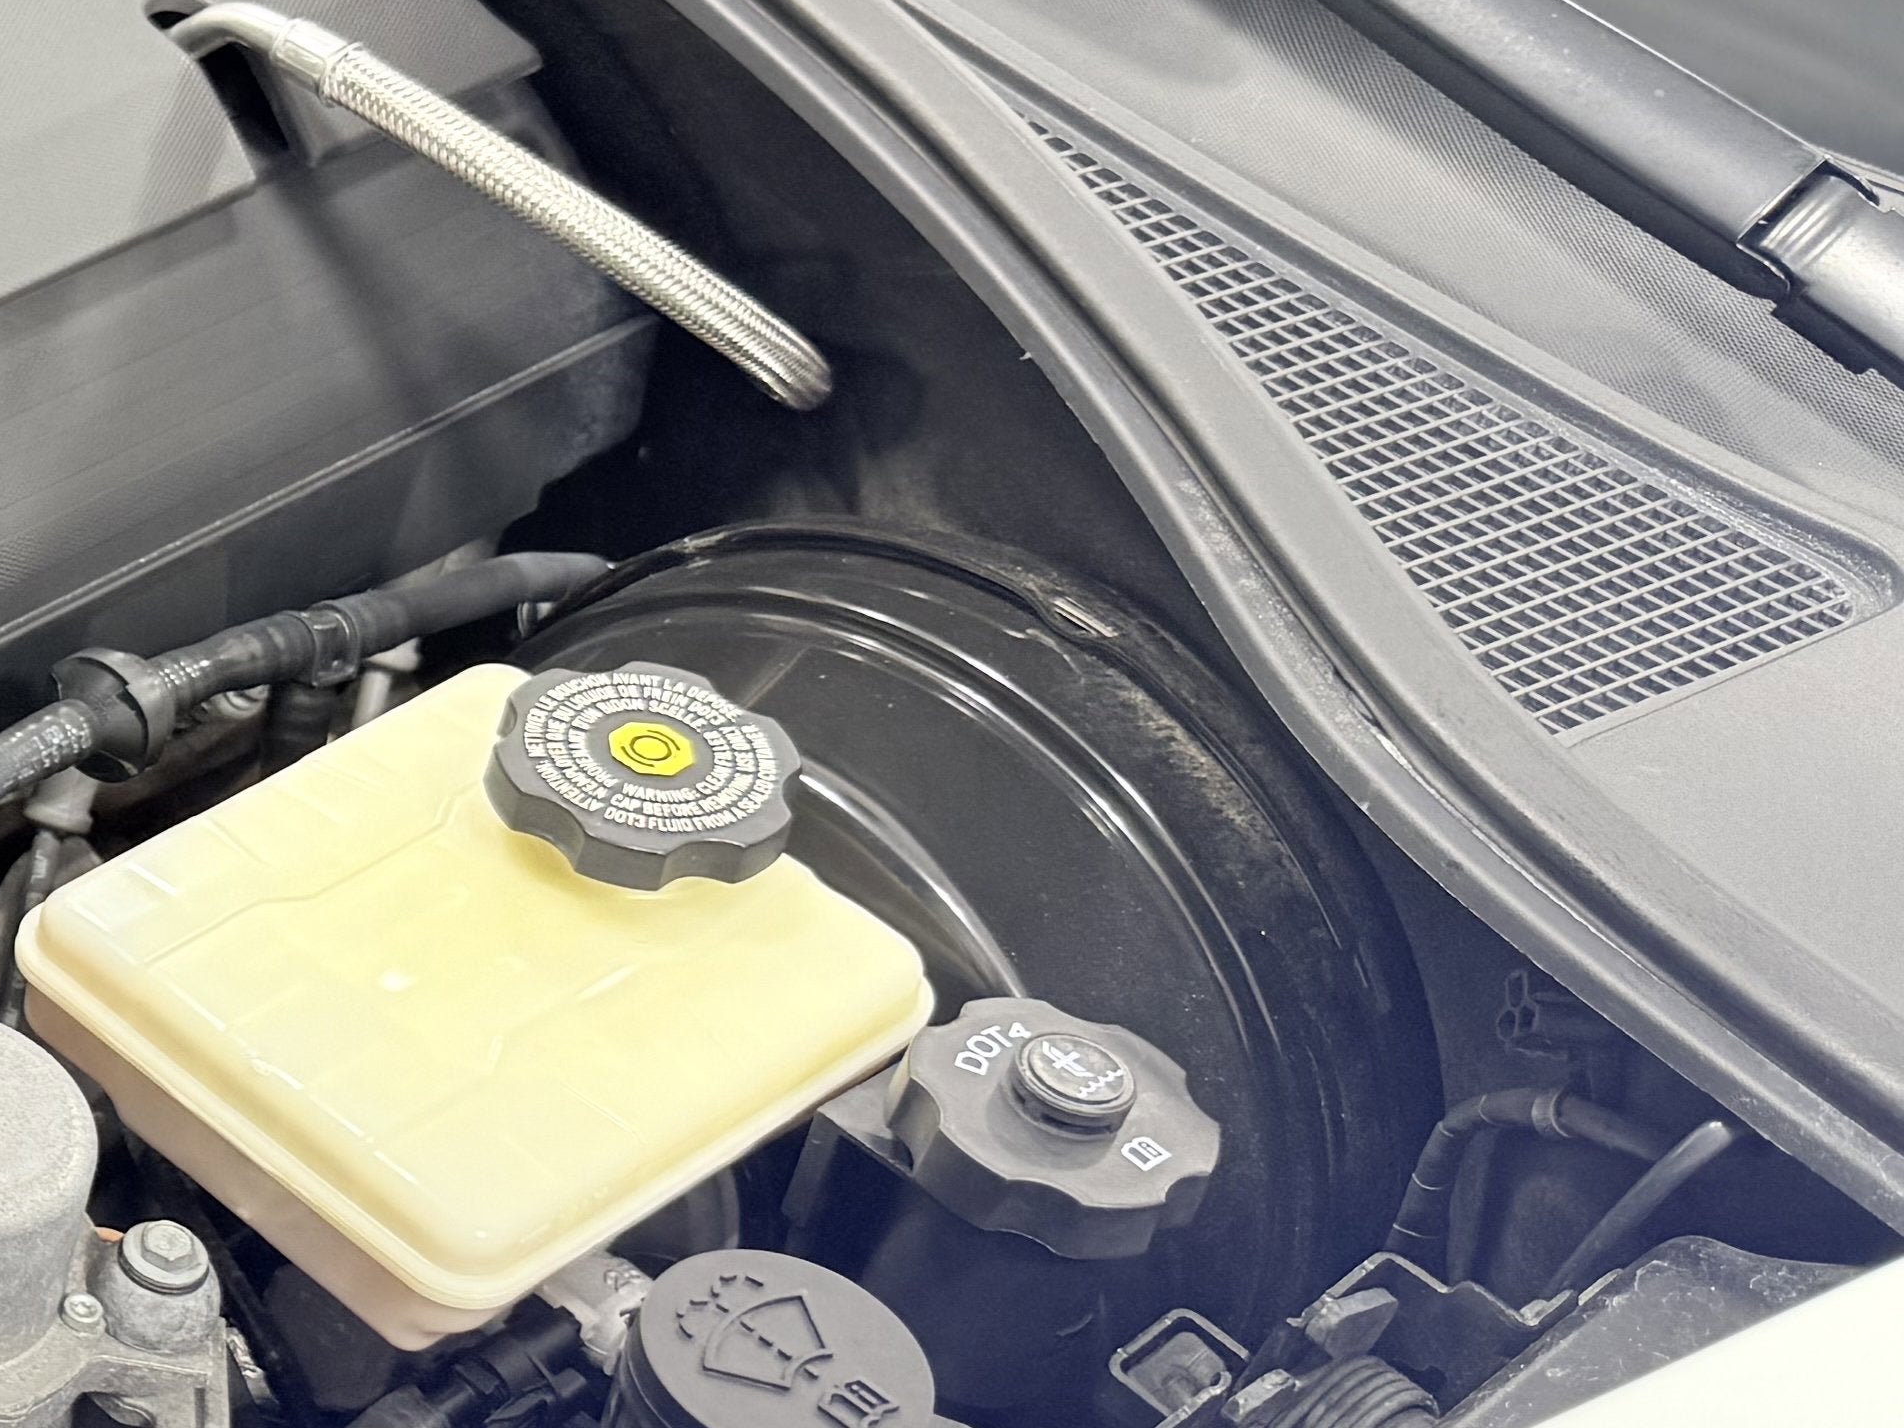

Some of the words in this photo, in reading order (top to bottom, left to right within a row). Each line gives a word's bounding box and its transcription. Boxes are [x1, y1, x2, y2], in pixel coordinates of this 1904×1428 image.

[546, 673, 612, 701] BOUCHON
[612, 672, 662, 687] AVANT
[662, 678, 687, 694] LA
[534, 695, 559, 711] LE
[564, 686, 616, 711] LIQUIDE
[616, 685, 641, 699] DE
[643, 686, 689, 707] FREIN
[551, 705, 576, 722] DU
[687, 700, 726, 726] DOT3
[524, 708, 549, 757] NETTOYER
[544, 718, 568, 741] QUE
[718, 726, 751, 751] ONLY
[568, 729, 619, 787] PROVENANT
[596, 698, 645, 714] BIDON
[703, 730, 733, 767] FILLER
[733, 751, 756, 773] USE
[695, 765, 732, 795] CLEAN
[610, 793, 639, 811] CAP
[622, 783, 700, 803] WARNING:
[604, 806, 646, 828] DOT3
[648, 816, 694, 832] FLUID
[692, 810, 737, 831] FROM
[737, 778, 775, 814] SEALED
[642, 801, 703, 817] BEFORE
